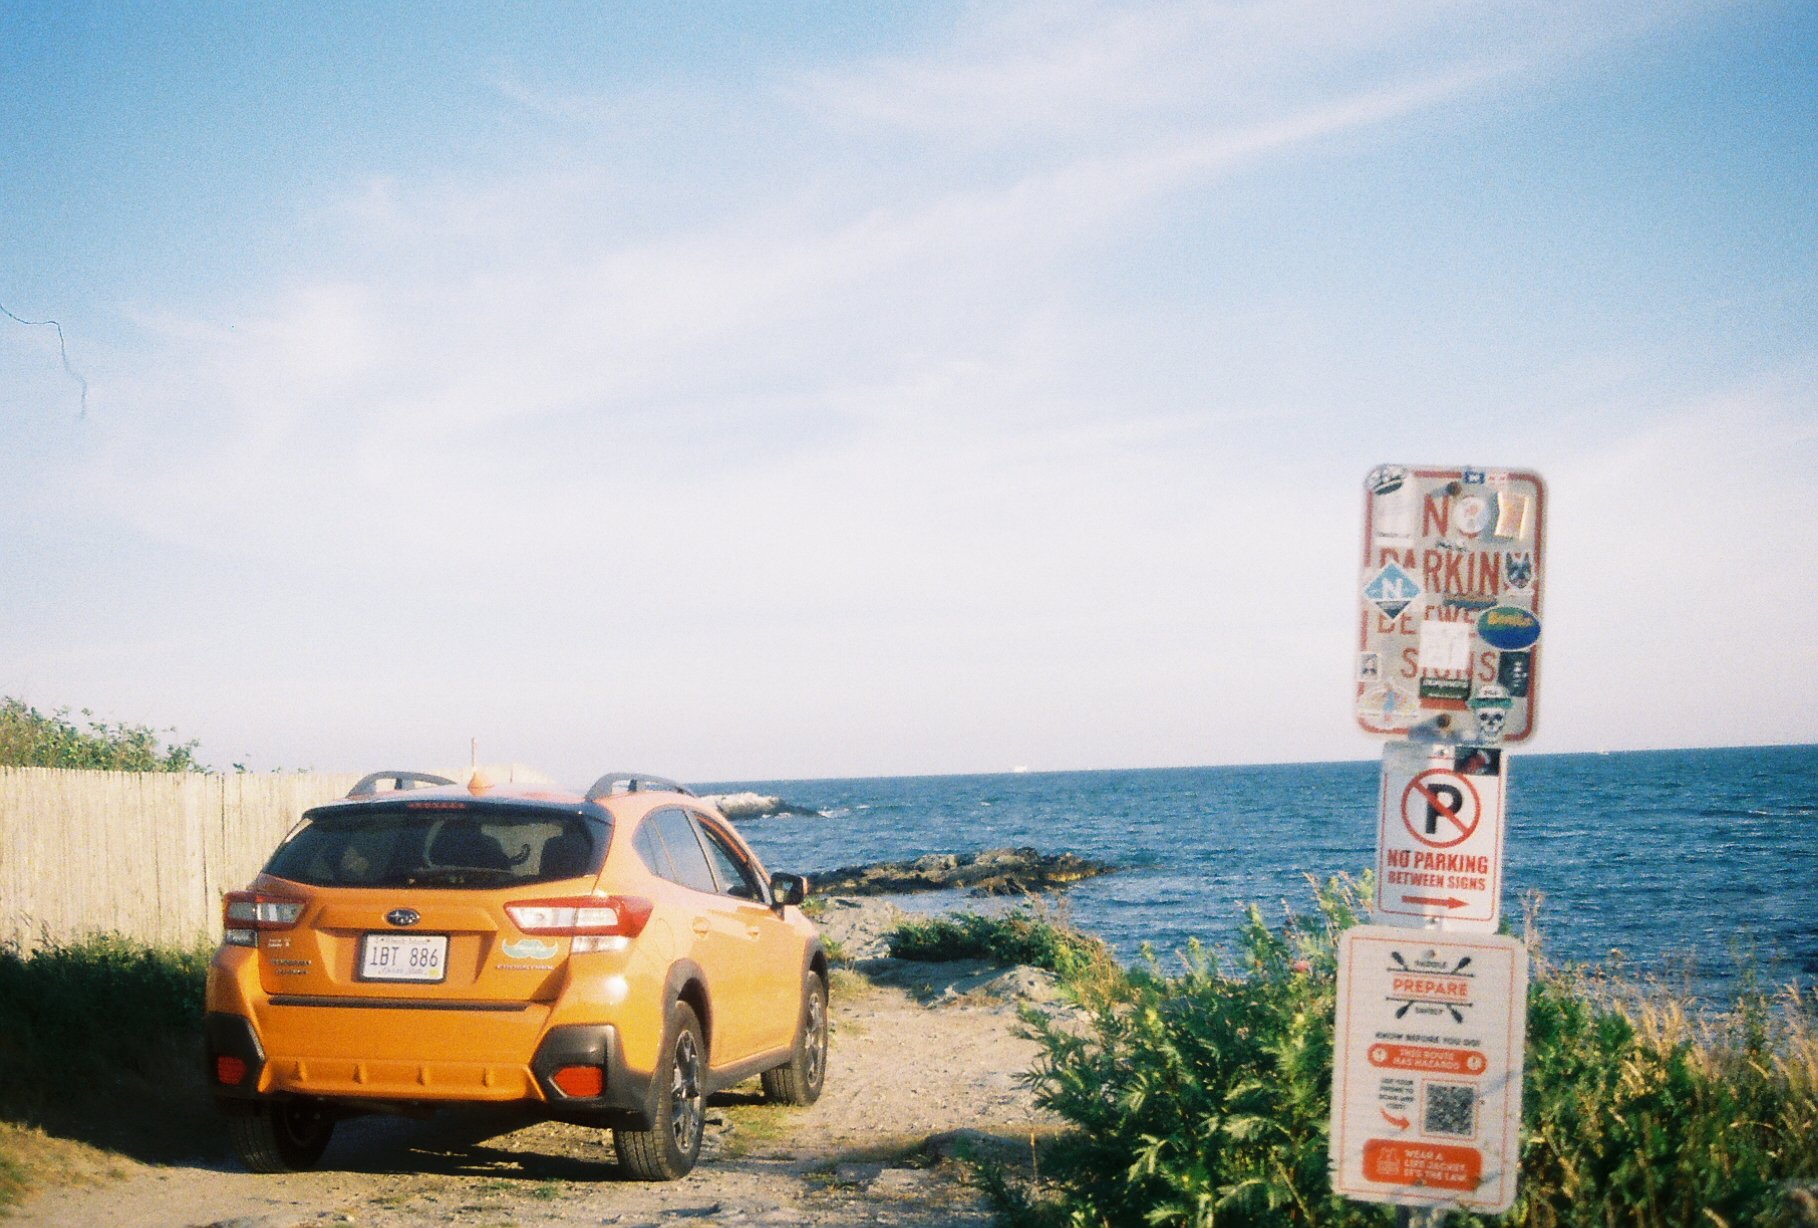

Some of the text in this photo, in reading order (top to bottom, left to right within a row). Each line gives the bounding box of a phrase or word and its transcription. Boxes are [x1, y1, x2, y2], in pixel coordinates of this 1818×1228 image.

[1379, 549, 1521, 596] PRKIN
[1387, 849, 1488, 875] NO PARKING
[1387, 871, 1486, 891] BETWEEN SIGNS
[409, 947, 438, 967] 886
[1393, 978, 1468, 996] PREPARE
